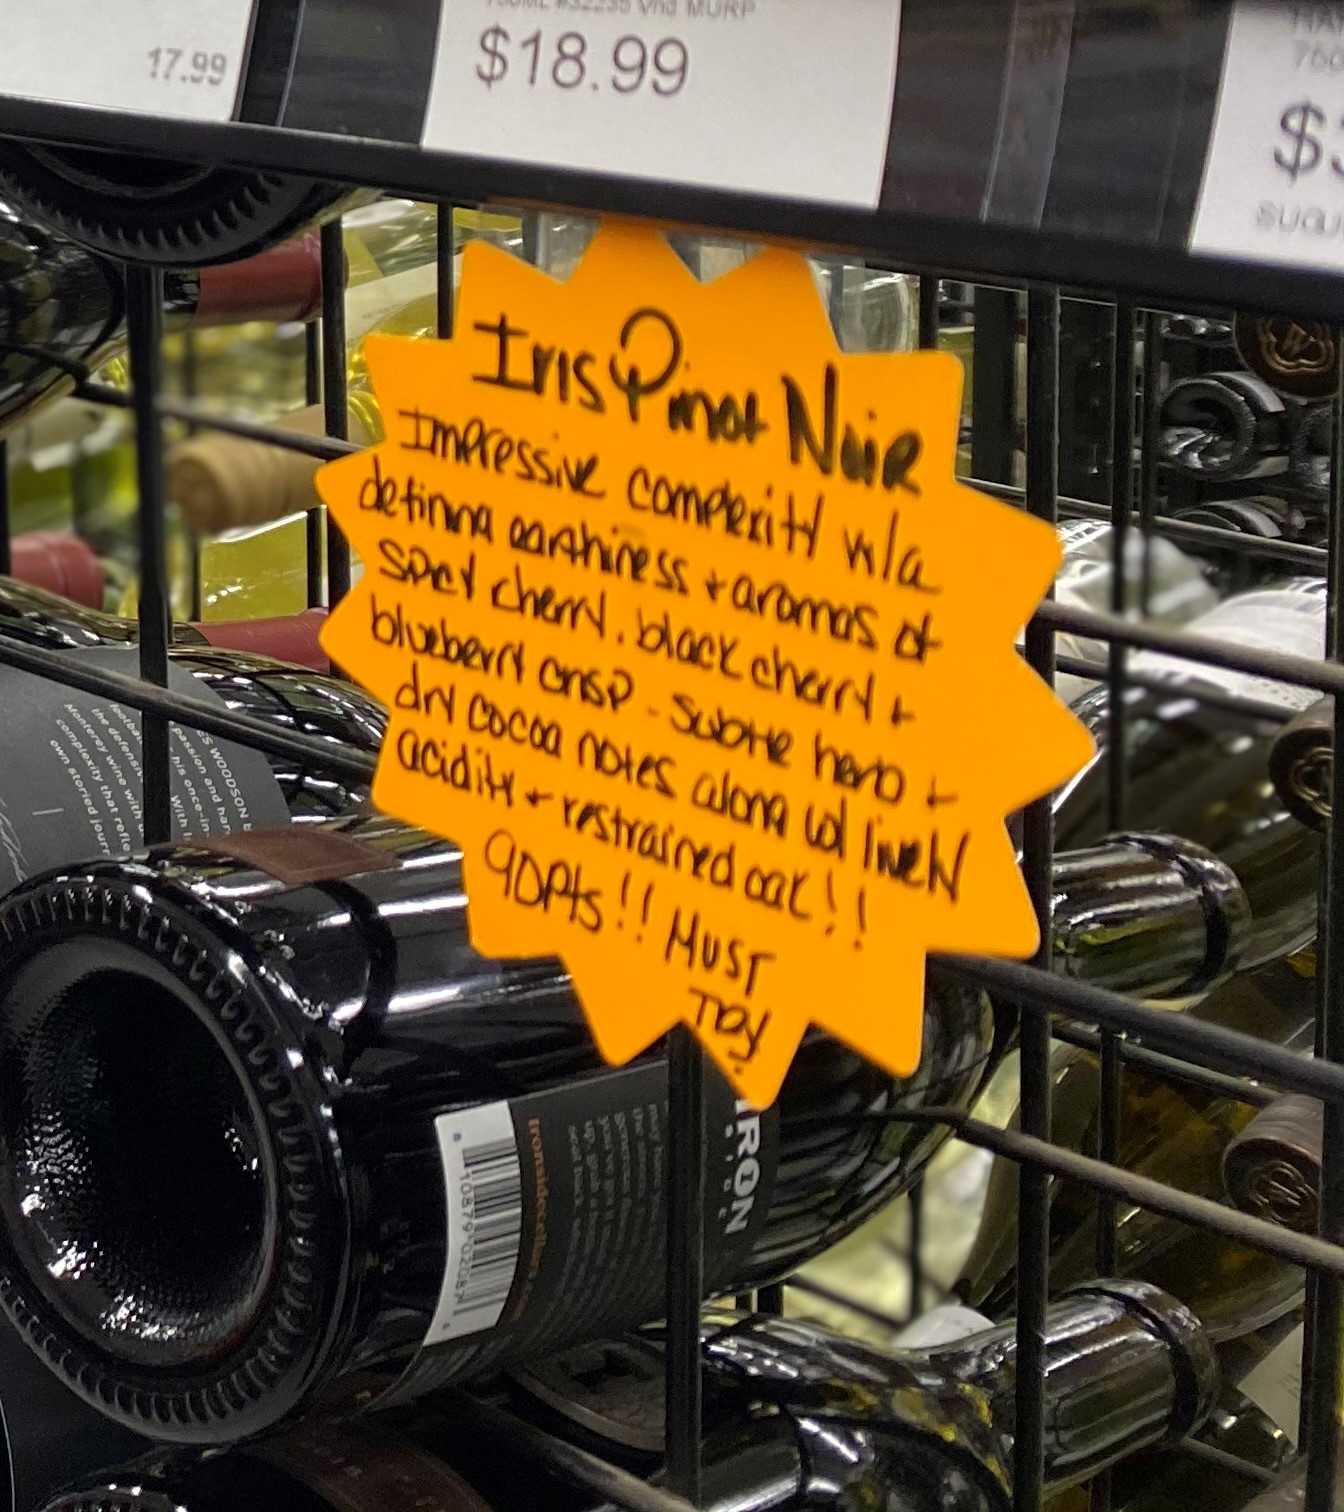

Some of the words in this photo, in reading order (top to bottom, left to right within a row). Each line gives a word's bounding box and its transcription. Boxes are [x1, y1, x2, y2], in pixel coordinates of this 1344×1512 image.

[146, 45, 229, 88] 17.99
[475, 22, 690, 99] $18.99
[472, 312, 606, 416] Iris
[609, 306, 769, 445] Pinot
[359, 454, 494, 544] defining
[510, 514, 690, 595] earthiness
[731, 573, 880, 652] aromas
[893, 610, 944, 667] of
[370, 591, 525, 685] blueberry
[669, 691, 795, 769] subtle
[378, 538, 477, 603] spicy
[636, 605, 743, 681] black
[750, 641, 876, 724] cherry
[49, 739, 71, 766] own
[67, 767, 100, 816] storied
[56, 718, 105, 783] complexity
[100, 784, 120, 815] that
[63, 702, 110, 754] Monterey
[105, 754, 128, 787] wine
[124, 788, 144, 821] with
[171, 726, 208, 775] passion
[203, 777, 224, 804] and
[209, 746, 250, 820] WOODSON
[394, 660, 457, 726] dry
[467, 691, 563, 758] cocoa
[577, 730, 678, 801] notes
[691, 768, 789, 840] along
[396, 727, 516, 810] acidity
[562, 793, 738, 891] restrained
